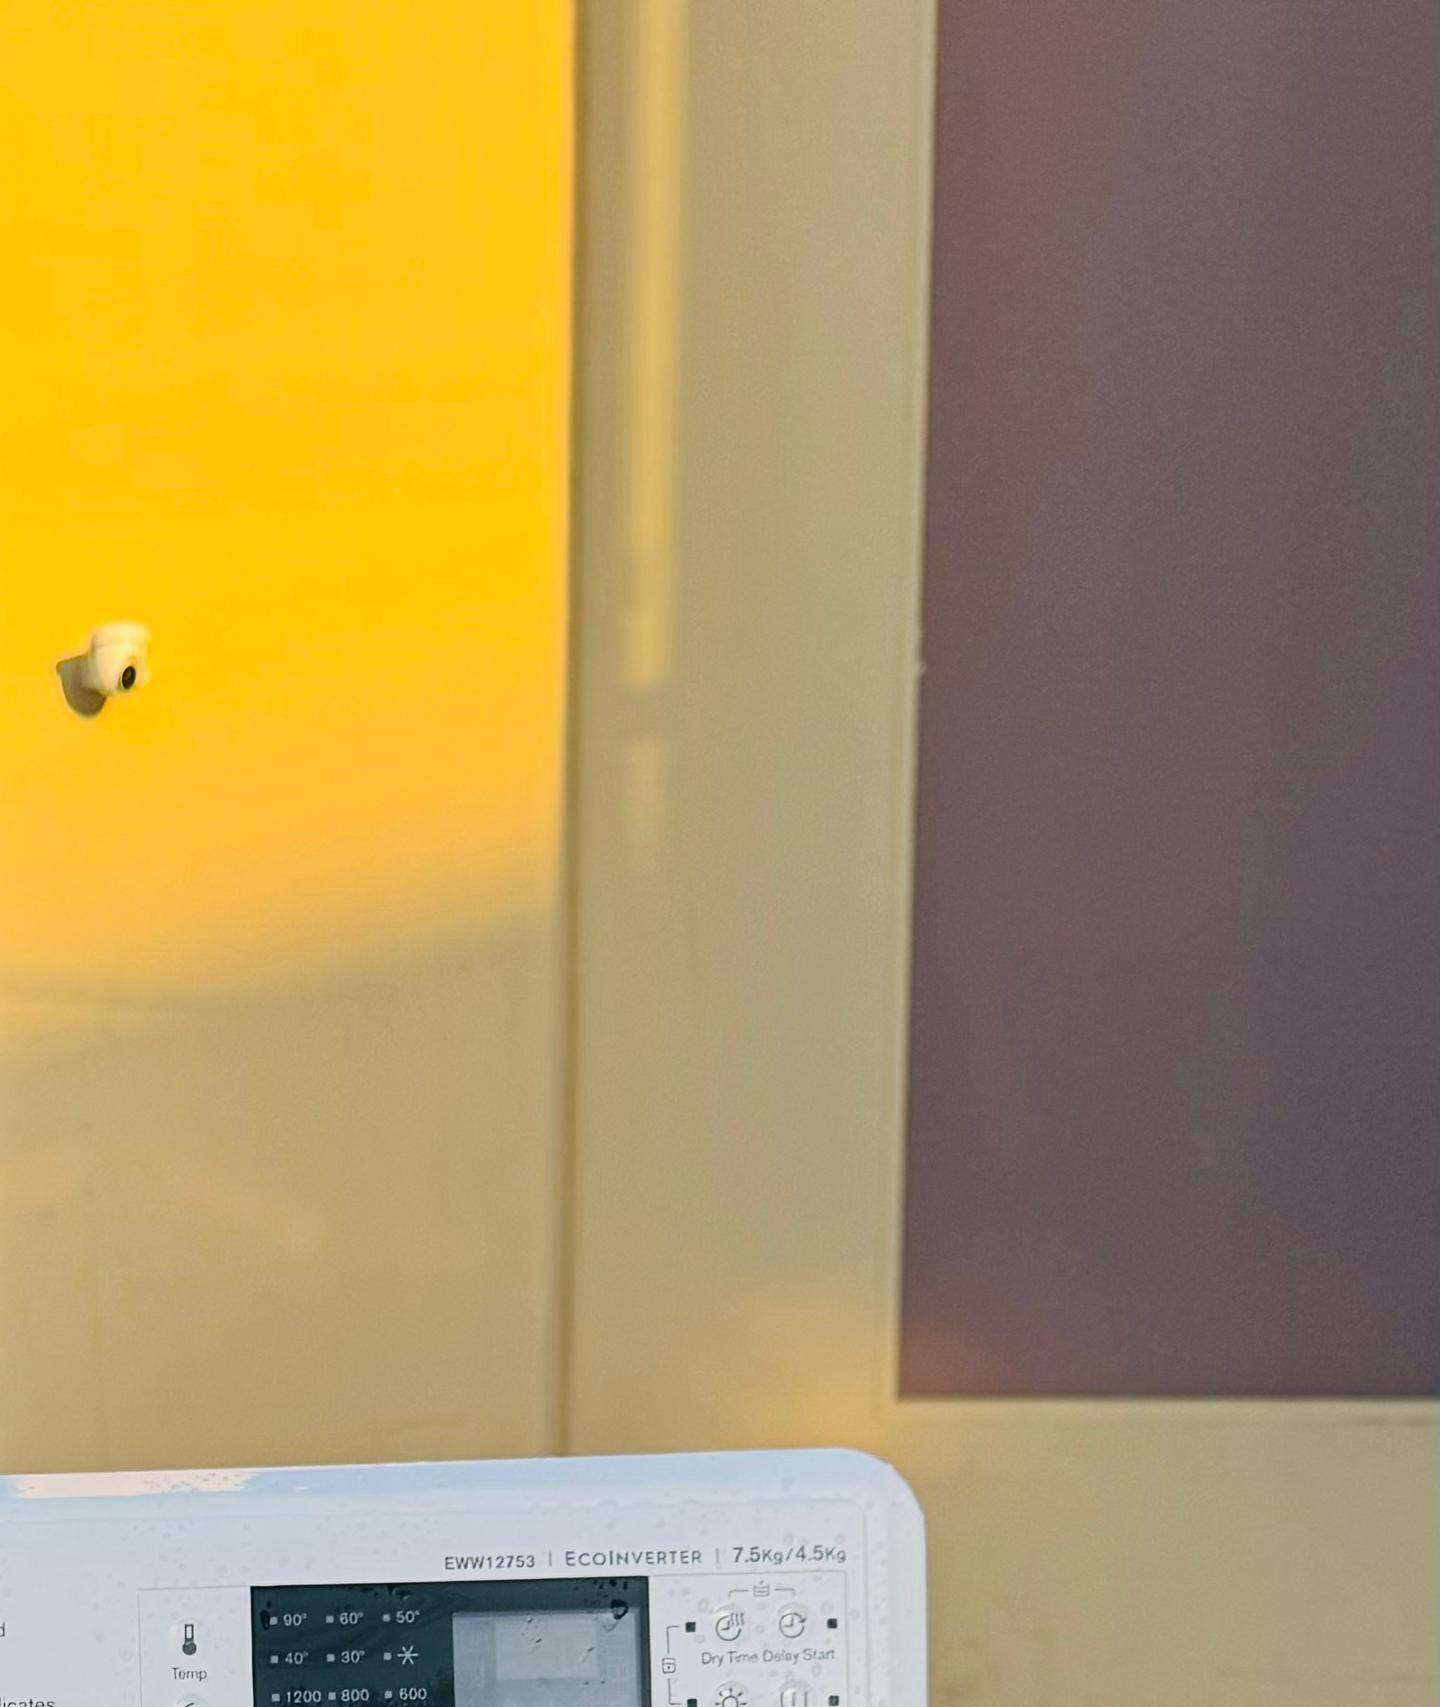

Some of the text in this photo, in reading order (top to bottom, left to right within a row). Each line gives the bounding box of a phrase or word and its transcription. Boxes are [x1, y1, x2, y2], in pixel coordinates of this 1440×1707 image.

[444, 1555, 535, 1571] EWW12753
[702, 1651, 758, 1667] Dry Time
[763, 1649, 835, 1664] Delay Start
[171, 1667, 208, 1682] Temp
[286, 1687, 427, 1703] 1200 800 600
